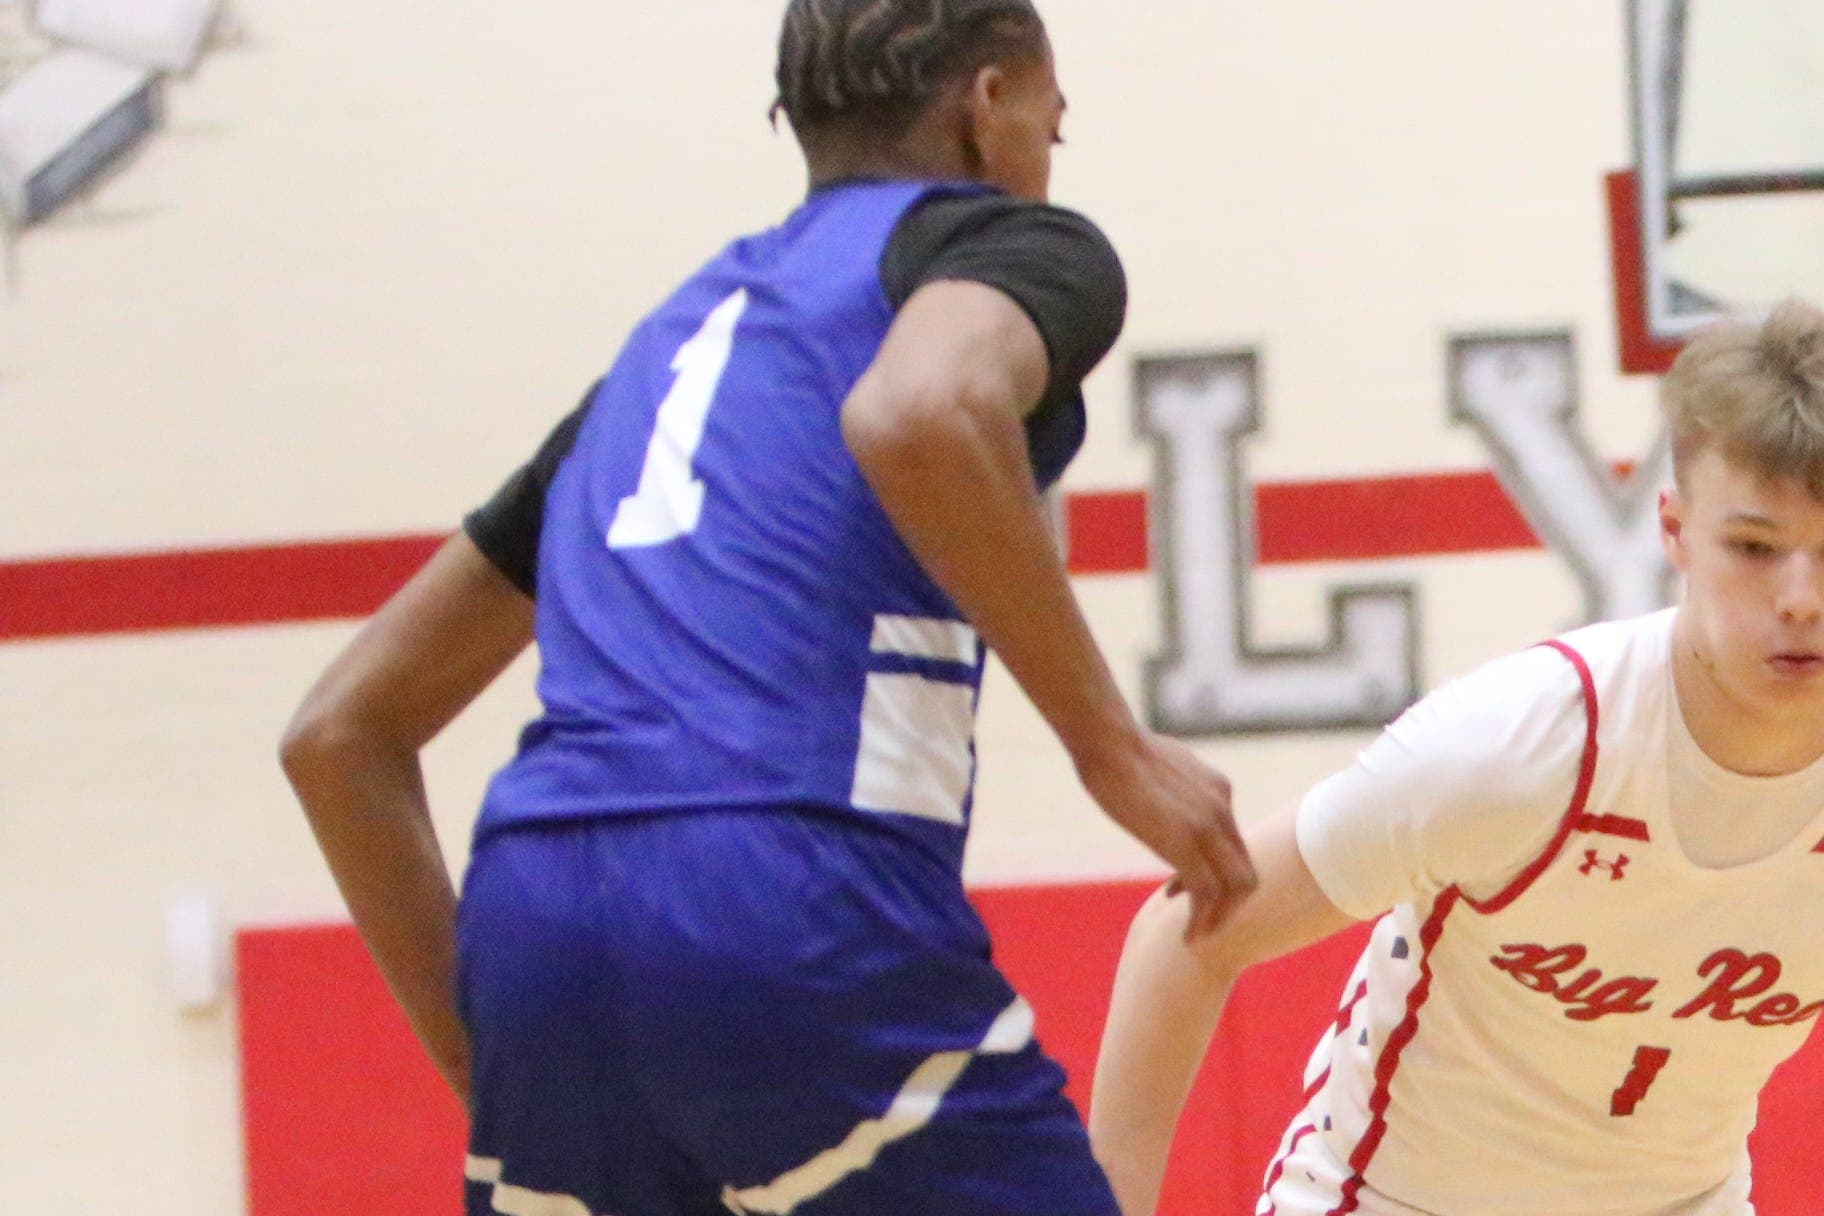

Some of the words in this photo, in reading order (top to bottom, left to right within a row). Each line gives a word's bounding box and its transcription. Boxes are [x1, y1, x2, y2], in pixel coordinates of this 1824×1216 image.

[606, 287, 748, 549] 1
[1489, 943, 1660, 1022] Big
[1610, 1045, 1671, 1117] 1
